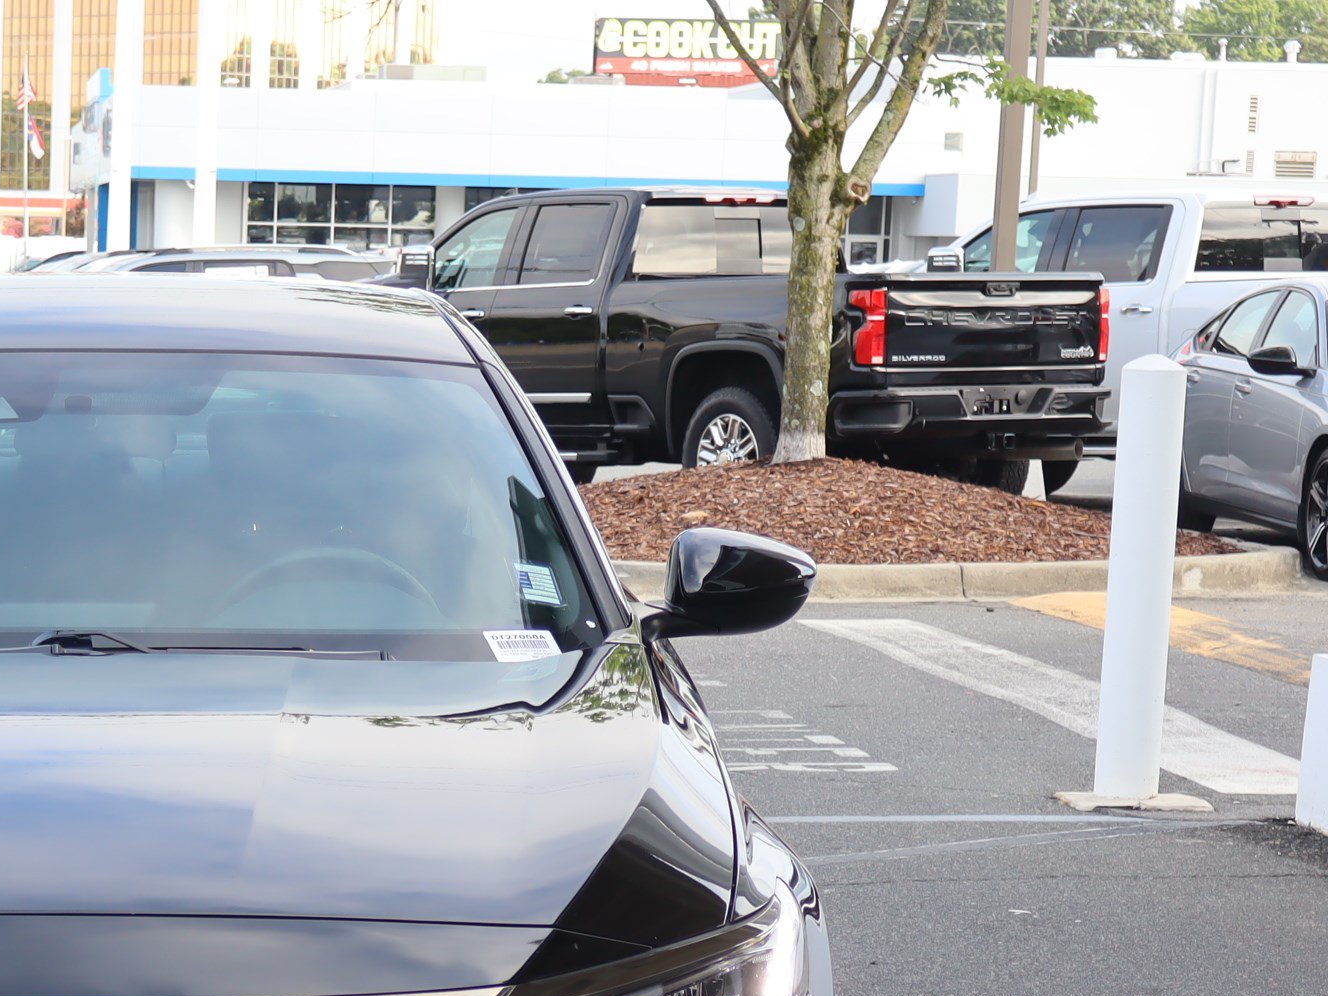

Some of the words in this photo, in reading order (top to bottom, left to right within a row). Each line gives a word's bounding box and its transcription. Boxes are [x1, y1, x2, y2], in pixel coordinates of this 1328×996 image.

[623, 20, 715, 59] COOK
[717, 20, 782, 59] OUT
[904, 310, 1088, 328] CHEVROLET
